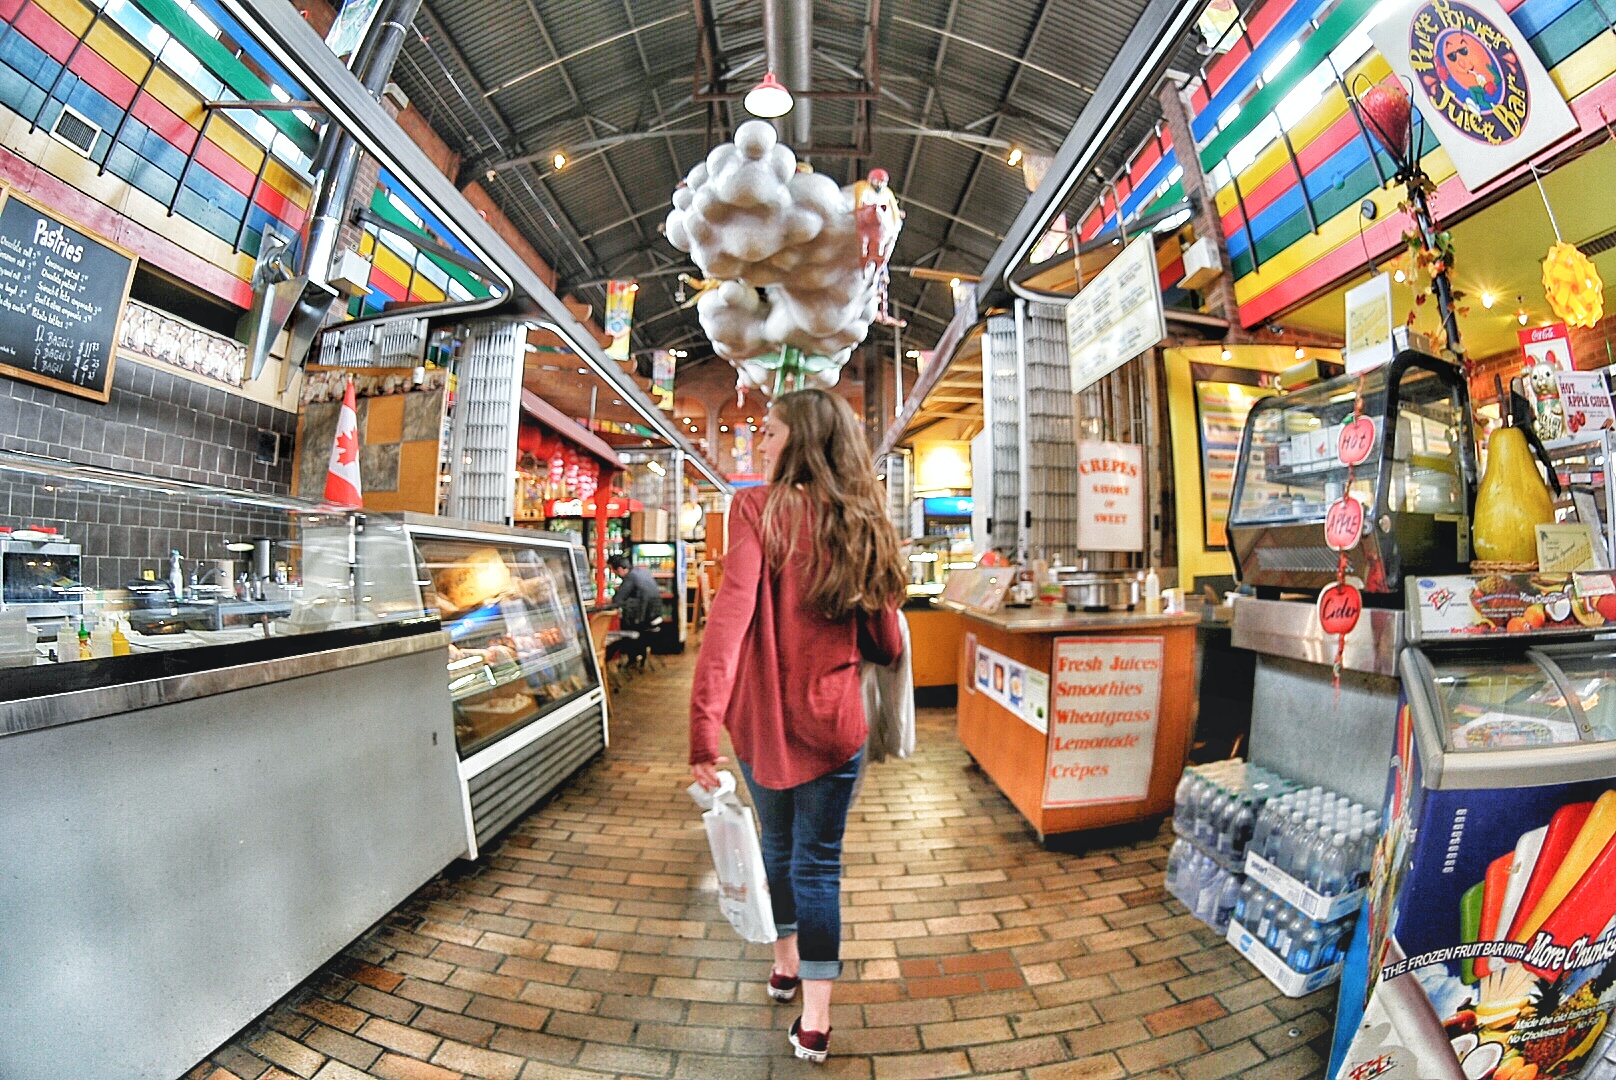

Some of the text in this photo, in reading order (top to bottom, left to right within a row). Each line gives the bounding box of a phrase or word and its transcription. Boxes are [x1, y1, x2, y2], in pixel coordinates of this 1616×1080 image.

[1410, 13, 1439, 72] Pure
[1430, 73, 1526, 145] Juice Bar
[34, 218, 84, 263] Pastries
[35, 324, 45, 342] 12
[35, 342, 41, 356] 6
[1559, 382, 1576, 394] HOT
[1568, 396, 1610, 407] APPLE CIDER
[1080, 458, 1137, 478] CREPES
[1094, 513, 1128, 524] SWEET
[1327, 514, 1358, 536] APPLE
[1322, 598, 1358, 620] Cider
[1058, 656, 1159, 672] Fresh Juices
[1055, 682, 1143, 697] Smoothies
[1056, 709, 1150, 727] Wheatgrass
[1053, 733, 1139, 751] Lemonade
[1383, 960, 1407, 980] THE
[1407, 947, 1454, 971] FROZEN
[1452, 942, 1485, 960] FRUIT
[1482, 942, 1505, 956] BAR
[1502, 943, 1527, 959] WITH
[1526, 932, 1566, 971] More
[1513, 1019, 1538, 1030] Made
[1539, 1014, 1553, 1026] the
[1553, 1013, 1568, 1023] old
[1507, 1034, 1520, 1044] No
[1521, 1026, 1569, 1041] Cholesterol
